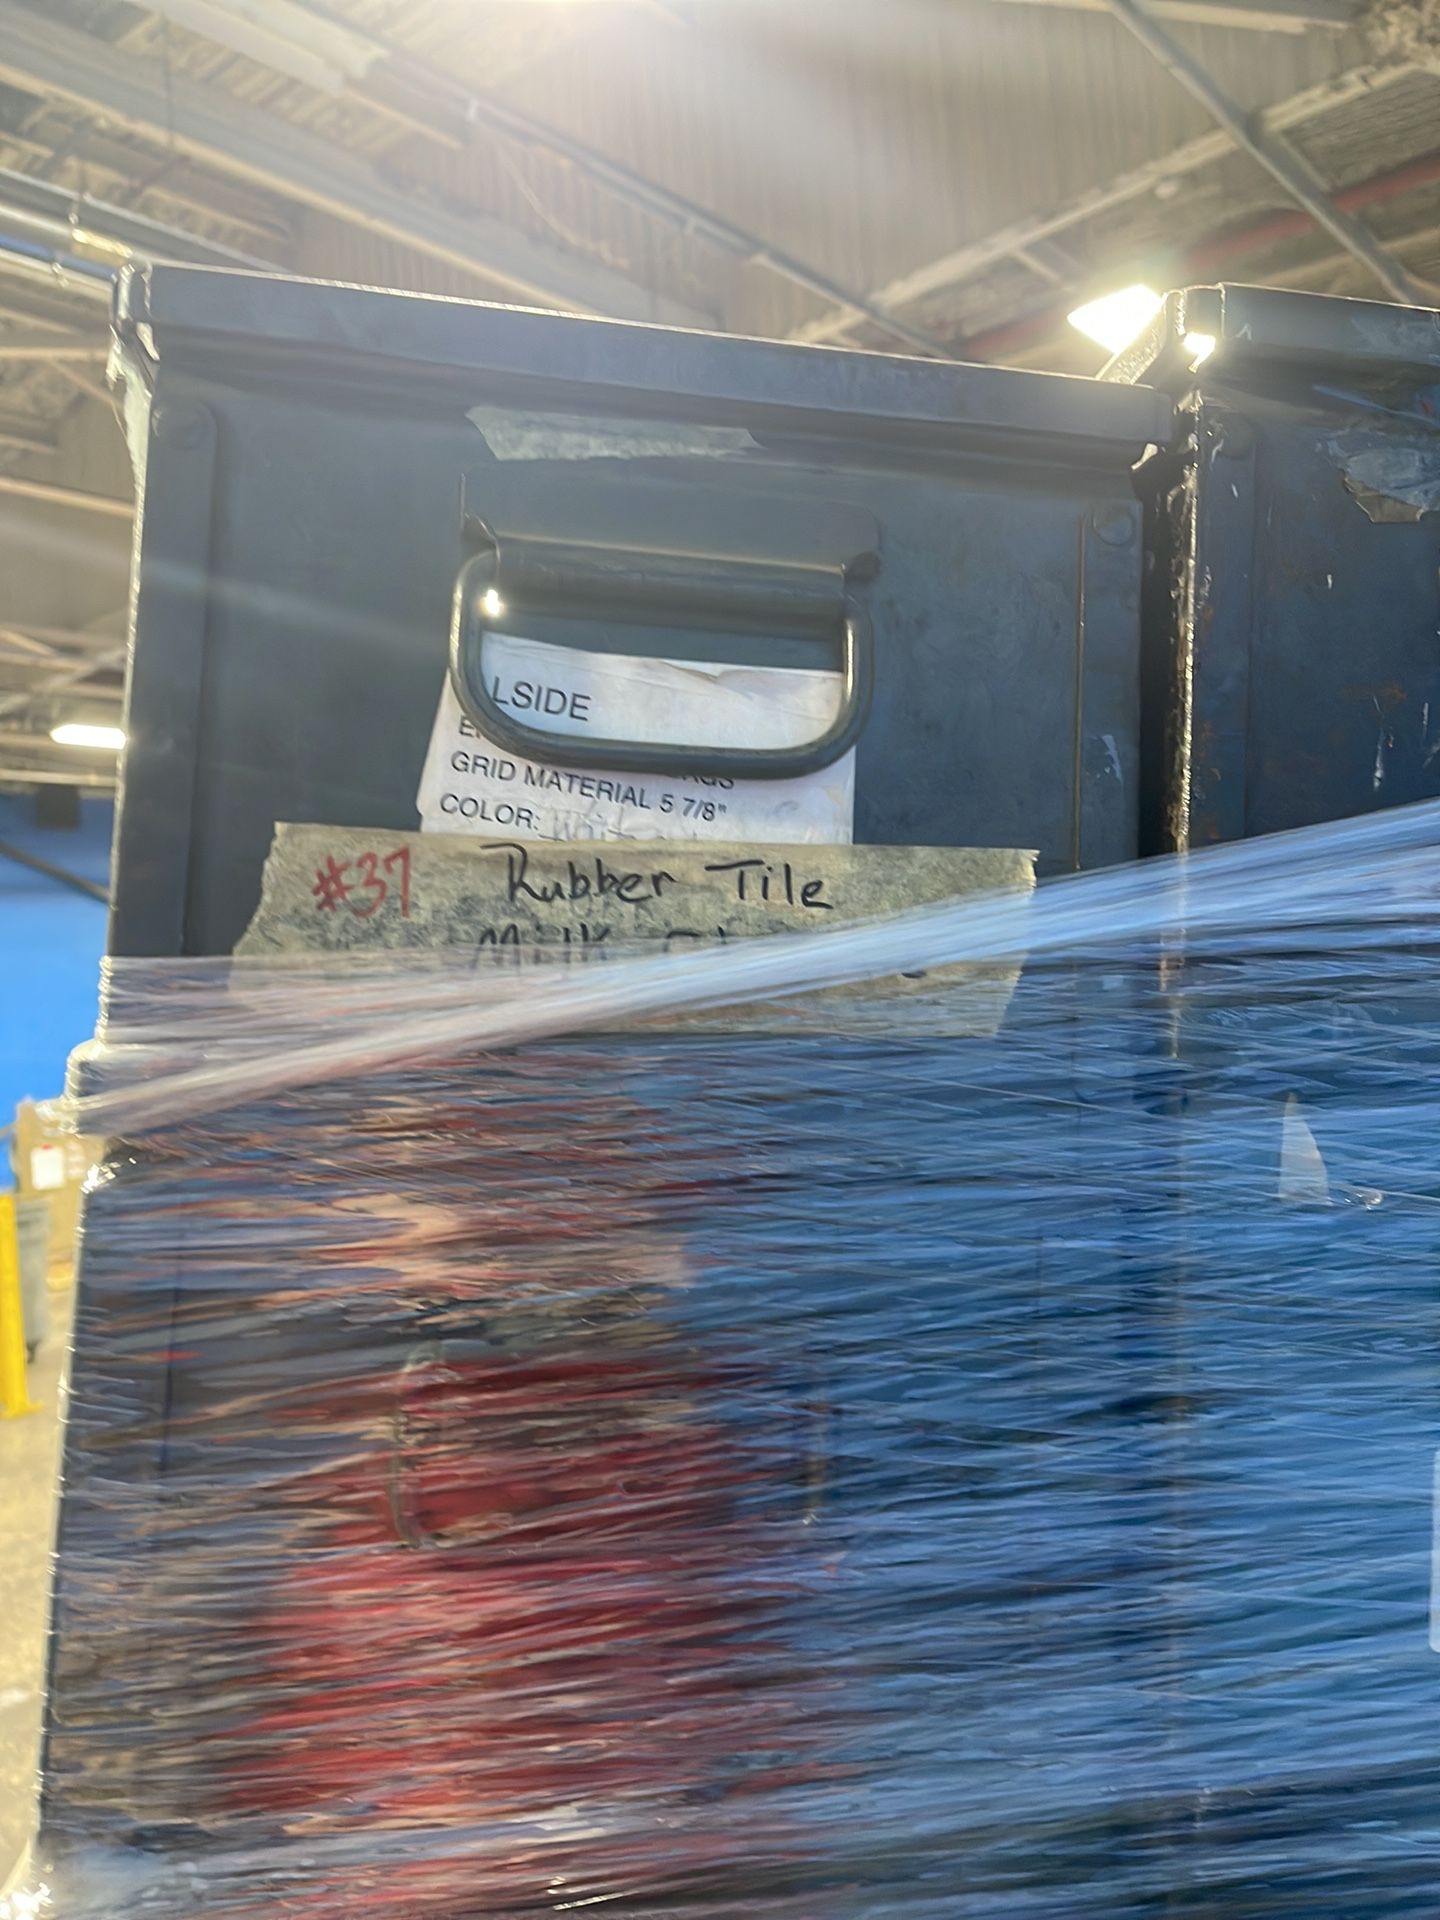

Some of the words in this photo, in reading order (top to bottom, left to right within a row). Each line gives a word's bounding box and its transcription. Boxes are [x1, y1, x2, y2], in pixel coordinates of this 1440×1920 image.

[491, 675, 592, 722] LSIDE
[439, 791, 541, 832] COLOR:
[450, 750, 517, 782] GRID
[524, 764, 652, 811] MATERIAL
[659, 793, 675, 814] 5
[682, 796, 728, 822] 7/8"
[479, 842, 676, 905] Rubber
[704, 859, 834, 910] Tile
